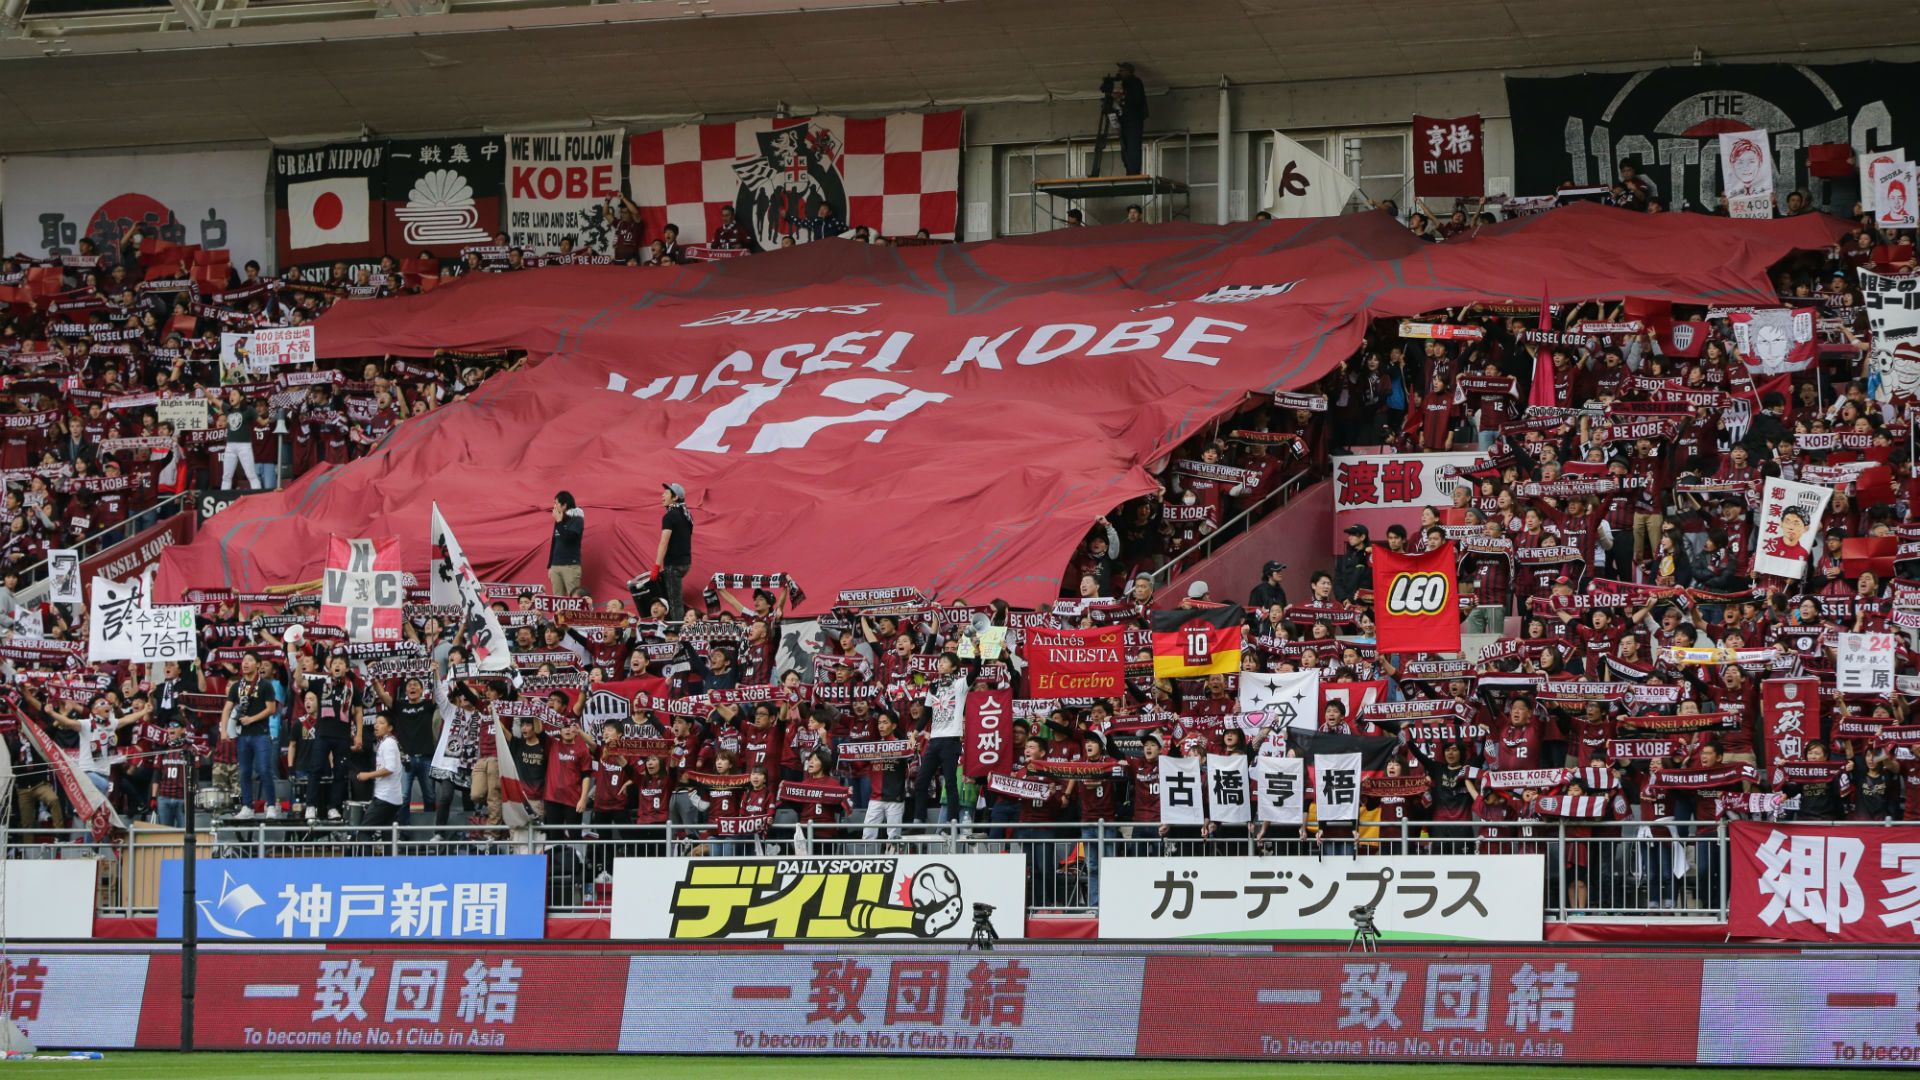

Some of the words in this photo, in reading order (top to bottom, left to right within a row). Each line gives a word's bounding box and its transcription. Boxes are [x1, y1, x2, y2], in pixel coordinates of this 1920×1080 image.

[1701, 95, 1743, 116] THE
[391, 141, 499, 163] 一戦集中
[511, 136, 529, 160] WE
[533, 136, 561, 161] WILL
[565, 135, 615, 161] FOLLOW
[278, 152, 324, 175] GREAT
[328, 147, 383, 169] NIPPON
[512, 165, 619, 199] KOBE
[512, 212, 530, 228] OVER
[532, 212, 550, 229] LAND
[550, 212, 565, 228] AND
[565, 212, 579, 228] SEA
[1903, 215, 1915, 224] 39
[513, 232, 525, 247] WE
[527, 232, 545, 247] WILL
[256, 332, 273, 342] 400
[941, 316, 1248, 374] KOBE
[1525, 331, 1559, 344] VISSEL
[1561, 334, 1587, 345] KOBE
[160, 400, 182, 409] Right
[184, 400, 205, 408] wing
[1666, 391, 1682, 404] BE
[1685, 391, 1719, 407] KOBE
[1613, 428, 1630, 438] BE
[1631, 421, 1663, 437] KOBE
[1179, 462, 1191, 471] WE
[1191, 463, 1216, 474] NEVER
[1216, 466, 1246, 477] FORGET
[101, 476, 129, 490] KOBE
[1337, 460, 1424, 505] 渡部
[1162, 506, 1178, 519] BE
[1180, 506, 1210, 519] KOBE
[97, 555, 142, 581] VISSEL
[140, 529, 175, 558] KOBE
[327, 571, 347, 603] V
[375, 573, 397, 606] C
[1388, 575, 1447, 613] LEO
[534, 599, 549, 611] BE
[552, 599, 584, 611] KOBE
[1573, 594, 1590, 608] BE
[1593, 593, 1628, 607] KOBE
[136, 611, 177, 630] 수호신
[179, 610, 192, 628] 18
[351, 607, 369, 638] F
[374, 627, 398, 638] 1995
[1032, 632, 1084, 646] Andrés
[13, 639, 38, 647] NEVER
[39, 640, 72, 650] FORGET
[140, 631, 192, 657] 김승규
[1187, 633, 1208, 656] 10
[1869, 636, 1892, 652] 24
[517, 653, 543, 663] NEVER
[545, 653, 576, 662] FORGET
[1049, 648, 1119, 662] INIESTA
[1408, 662, 1437, 673] NEVER
[1438, 661, 1471, 672] FORGET
[1039, 671, 1057, 689] El
[1059, 671, 1114, 688] Cerebro
[1842, 669, 1891, 689] 三原
[725, 689, 740, 701] BE
[741, 687, 771, 700] KOBE
[652, 697, 666, 710] BE
[667, 700, 694, 714] KOBE
[1363, 705, 1377, 715] WE
[1377, 704, 1406, 715] NEVER
[1407, 701, 1440, 712] FORGET
[977, 695, 1002, 764] 승짱
[1643, 720, 1677, 730] VISSEL
[1682, 717, 1713, 727] KOBE
[1773, 702, 1806, 765] 一致団
[846, 743, 876, 754] NEVER
[877, 741, 911, 752] FORGET
[1615, 743, 1633, 757] BE
[1634, 742, 1672, 756] KOBE
[167, 767, 178, 779] 10
[1492, 771, 1525, 781] VISSEL
[1526, 770, 1552, 780] KOBE
[1661, 774, 1688, 784] VISSEL
[1688, 774, 1708, 783] KOBE
[1784, 766, 1808, 776] VISSEL
[1808, 767, 1828, 777] KOBE
[994, 775, 1021, 788] VISSEL
[1022, 779, 1043, 793] KOBE
[1165, 771, 1196, 807] 古
[1213, 769, 1244, 806] 橋
[1264, 772, 1298, 807] 亨
[1322, 769, 1356, 806] 梧
[776, 861, 828, 874] DAILY
[829, 860, 896, 874] SPORTS
[1150, 866, 1489, 920] ガーデンプラス
[276, 882, 508, 938] 神戸新聞
[243, 958, 524, 1024] 一致団結
[732, 959, 1030, 1028] 一致団結
[1256, 962, 1581, 1033] 一致団結
[244, 1027, 263, 1046] To
[267, 1027, 332, 1046] become
[336, 1027, 361, 1046] the
[366, 1027, 402, 1046] No.1
[406, 1027, 443, 1046] Club
[449, 1027, 463, 1046] in
[469, 1027, 506, 1046] Asia
[734, 1030, 754, 1048] To
[757, 1030, 827, 1048] become
[833, 1030, 860, 1048] the
[864, 1031, 905, 1049] No.1
[908, 1031, 950, 1049] Club
[954, 1031, 969, 1049] in
[973, 1032, 1014, 1050] Asia
[1260, 1036, 1281, 1054] To
[1286, 1036, 1362, 1054] become
[1367, 1037, 1396, 1055] the
[1403, 1037, 1444, 1055] No.1
[1448, 1038, 1493, 1056] Club
[1499, 1038, 1515, 1056] in
[1519, 1039, 1563, 1057] Asia
[1832, 1042, 1855, 1061] To
